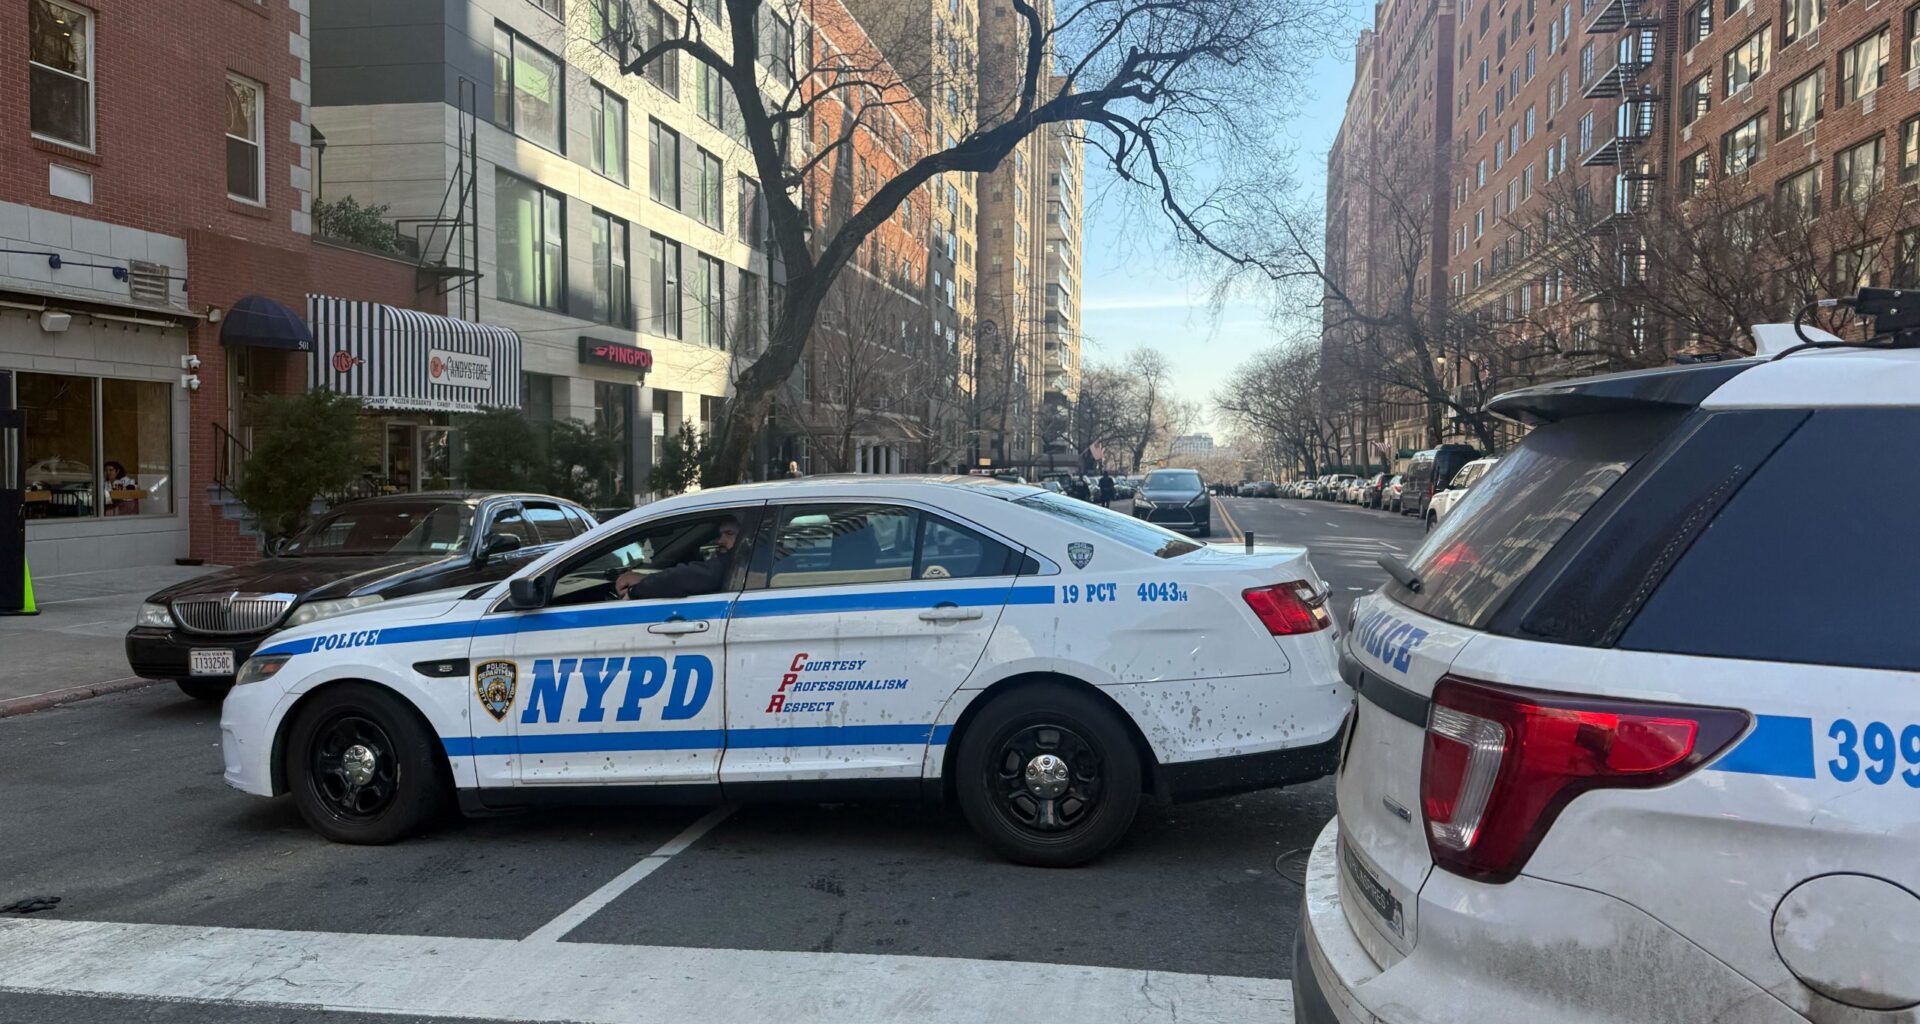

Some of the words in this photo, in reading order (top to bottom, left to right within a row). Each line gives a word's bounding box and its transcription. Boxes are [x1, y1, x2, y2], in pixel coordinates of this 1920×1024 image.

[298, 340, 310, 350] 501
[609, 345, 651, 367] PINGPO
[1062, 584, 1079, 604] 19
[1086, 582, 1117, 602] PCT
[313, 629, 380, 652] POLICE
[1355, 606, 1430, 675] POLICE
[520, 654, 714, 724] NYPD
